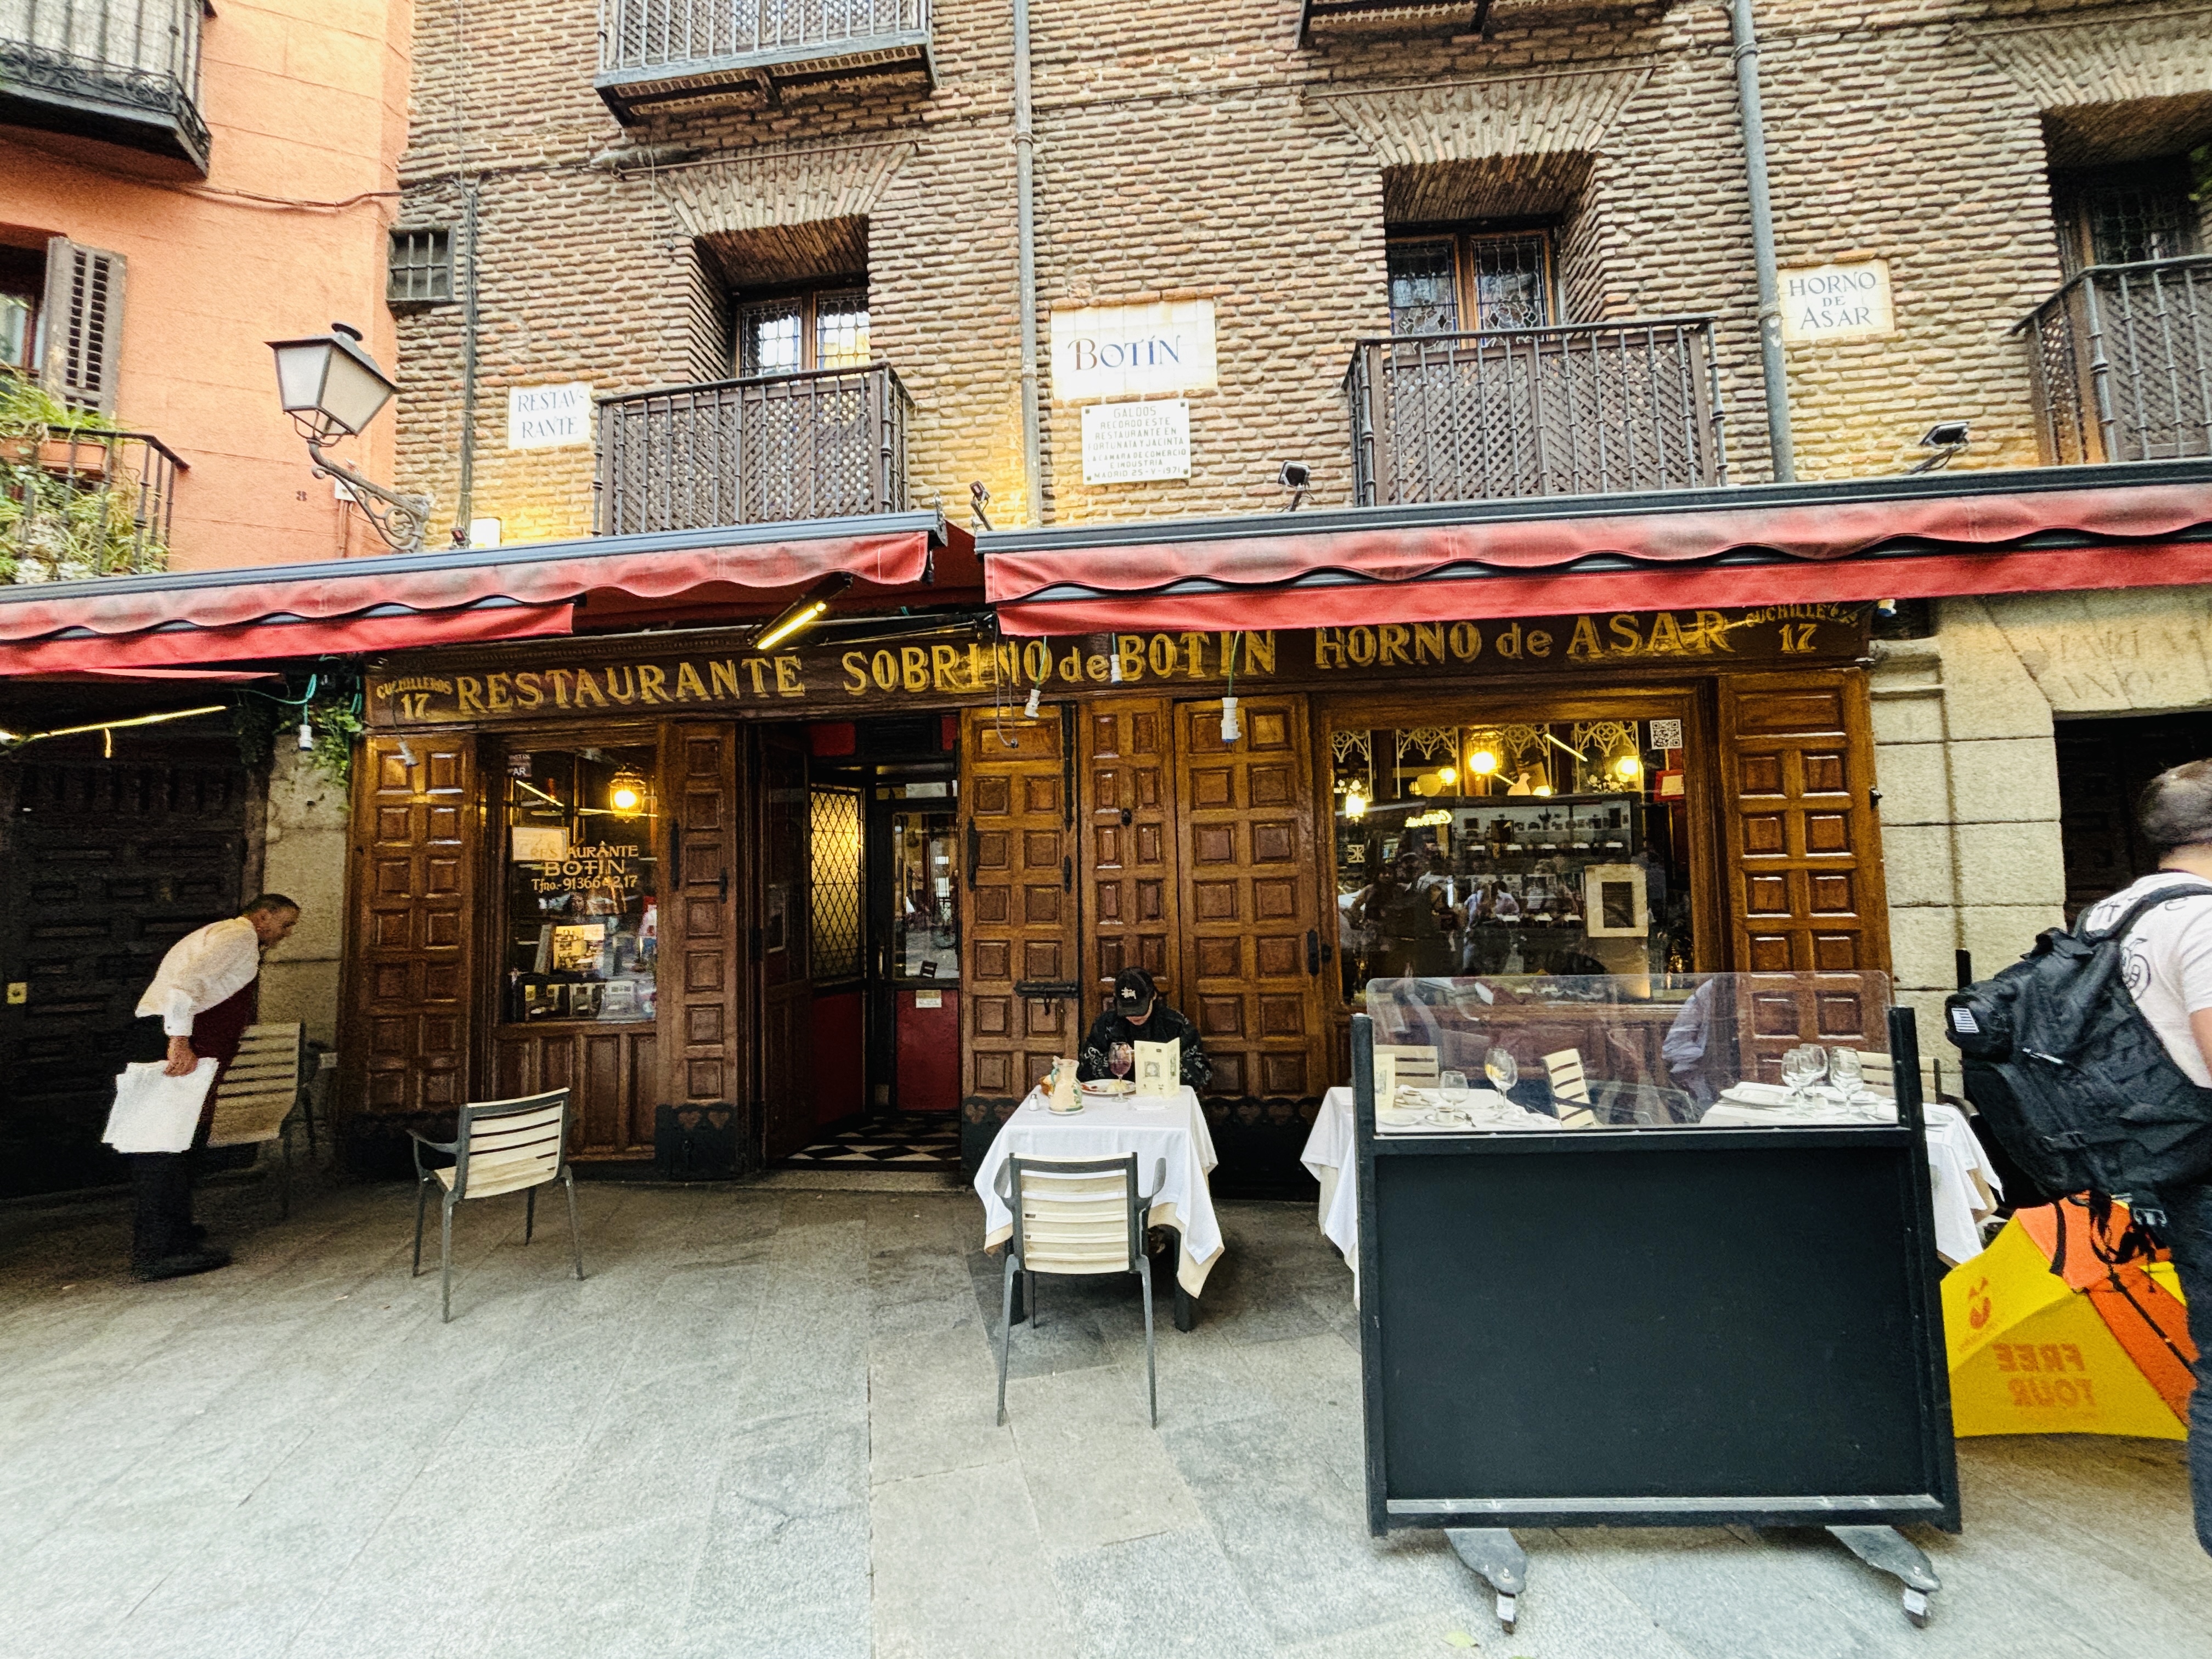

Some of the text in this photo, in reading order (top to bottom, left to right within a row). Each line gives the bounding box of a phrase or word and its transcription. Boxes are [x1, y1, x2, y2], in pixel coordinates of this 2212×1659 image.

[1789, 272, 1876, 296] HORNO
[1822, 295, 1846, 307] DE
[1799, 307, 1873, 330] ASAR
[1068, 335, 1181, 370] BOTÍN
[522, 416, 578, 438] RANTE
[1146, 417, 1170, 426] ESTE
[1095, 428, 1160, 440] RESTAURANTE
[1088, 441, 1137, 451] FORTUNATA
[1146, 437, 1184, 447] JACINTA
[1145, 448, 1186, 458] COMERCIO
[1118, 459, 1163, 468] INDUSTRIA
[1094, 470, 1128, 478] MADRID
[1746, 603, 1858, 627] CUCHILLE
[1779, 623, 1817, 654] 17
[455, 610, 1736, 714] RESTAURANTE SOBRINO de BOTIN HORNO de ASAR
[400, 693, 431, 720] 17
[530, 845, 639, 860] RESAURANTE
